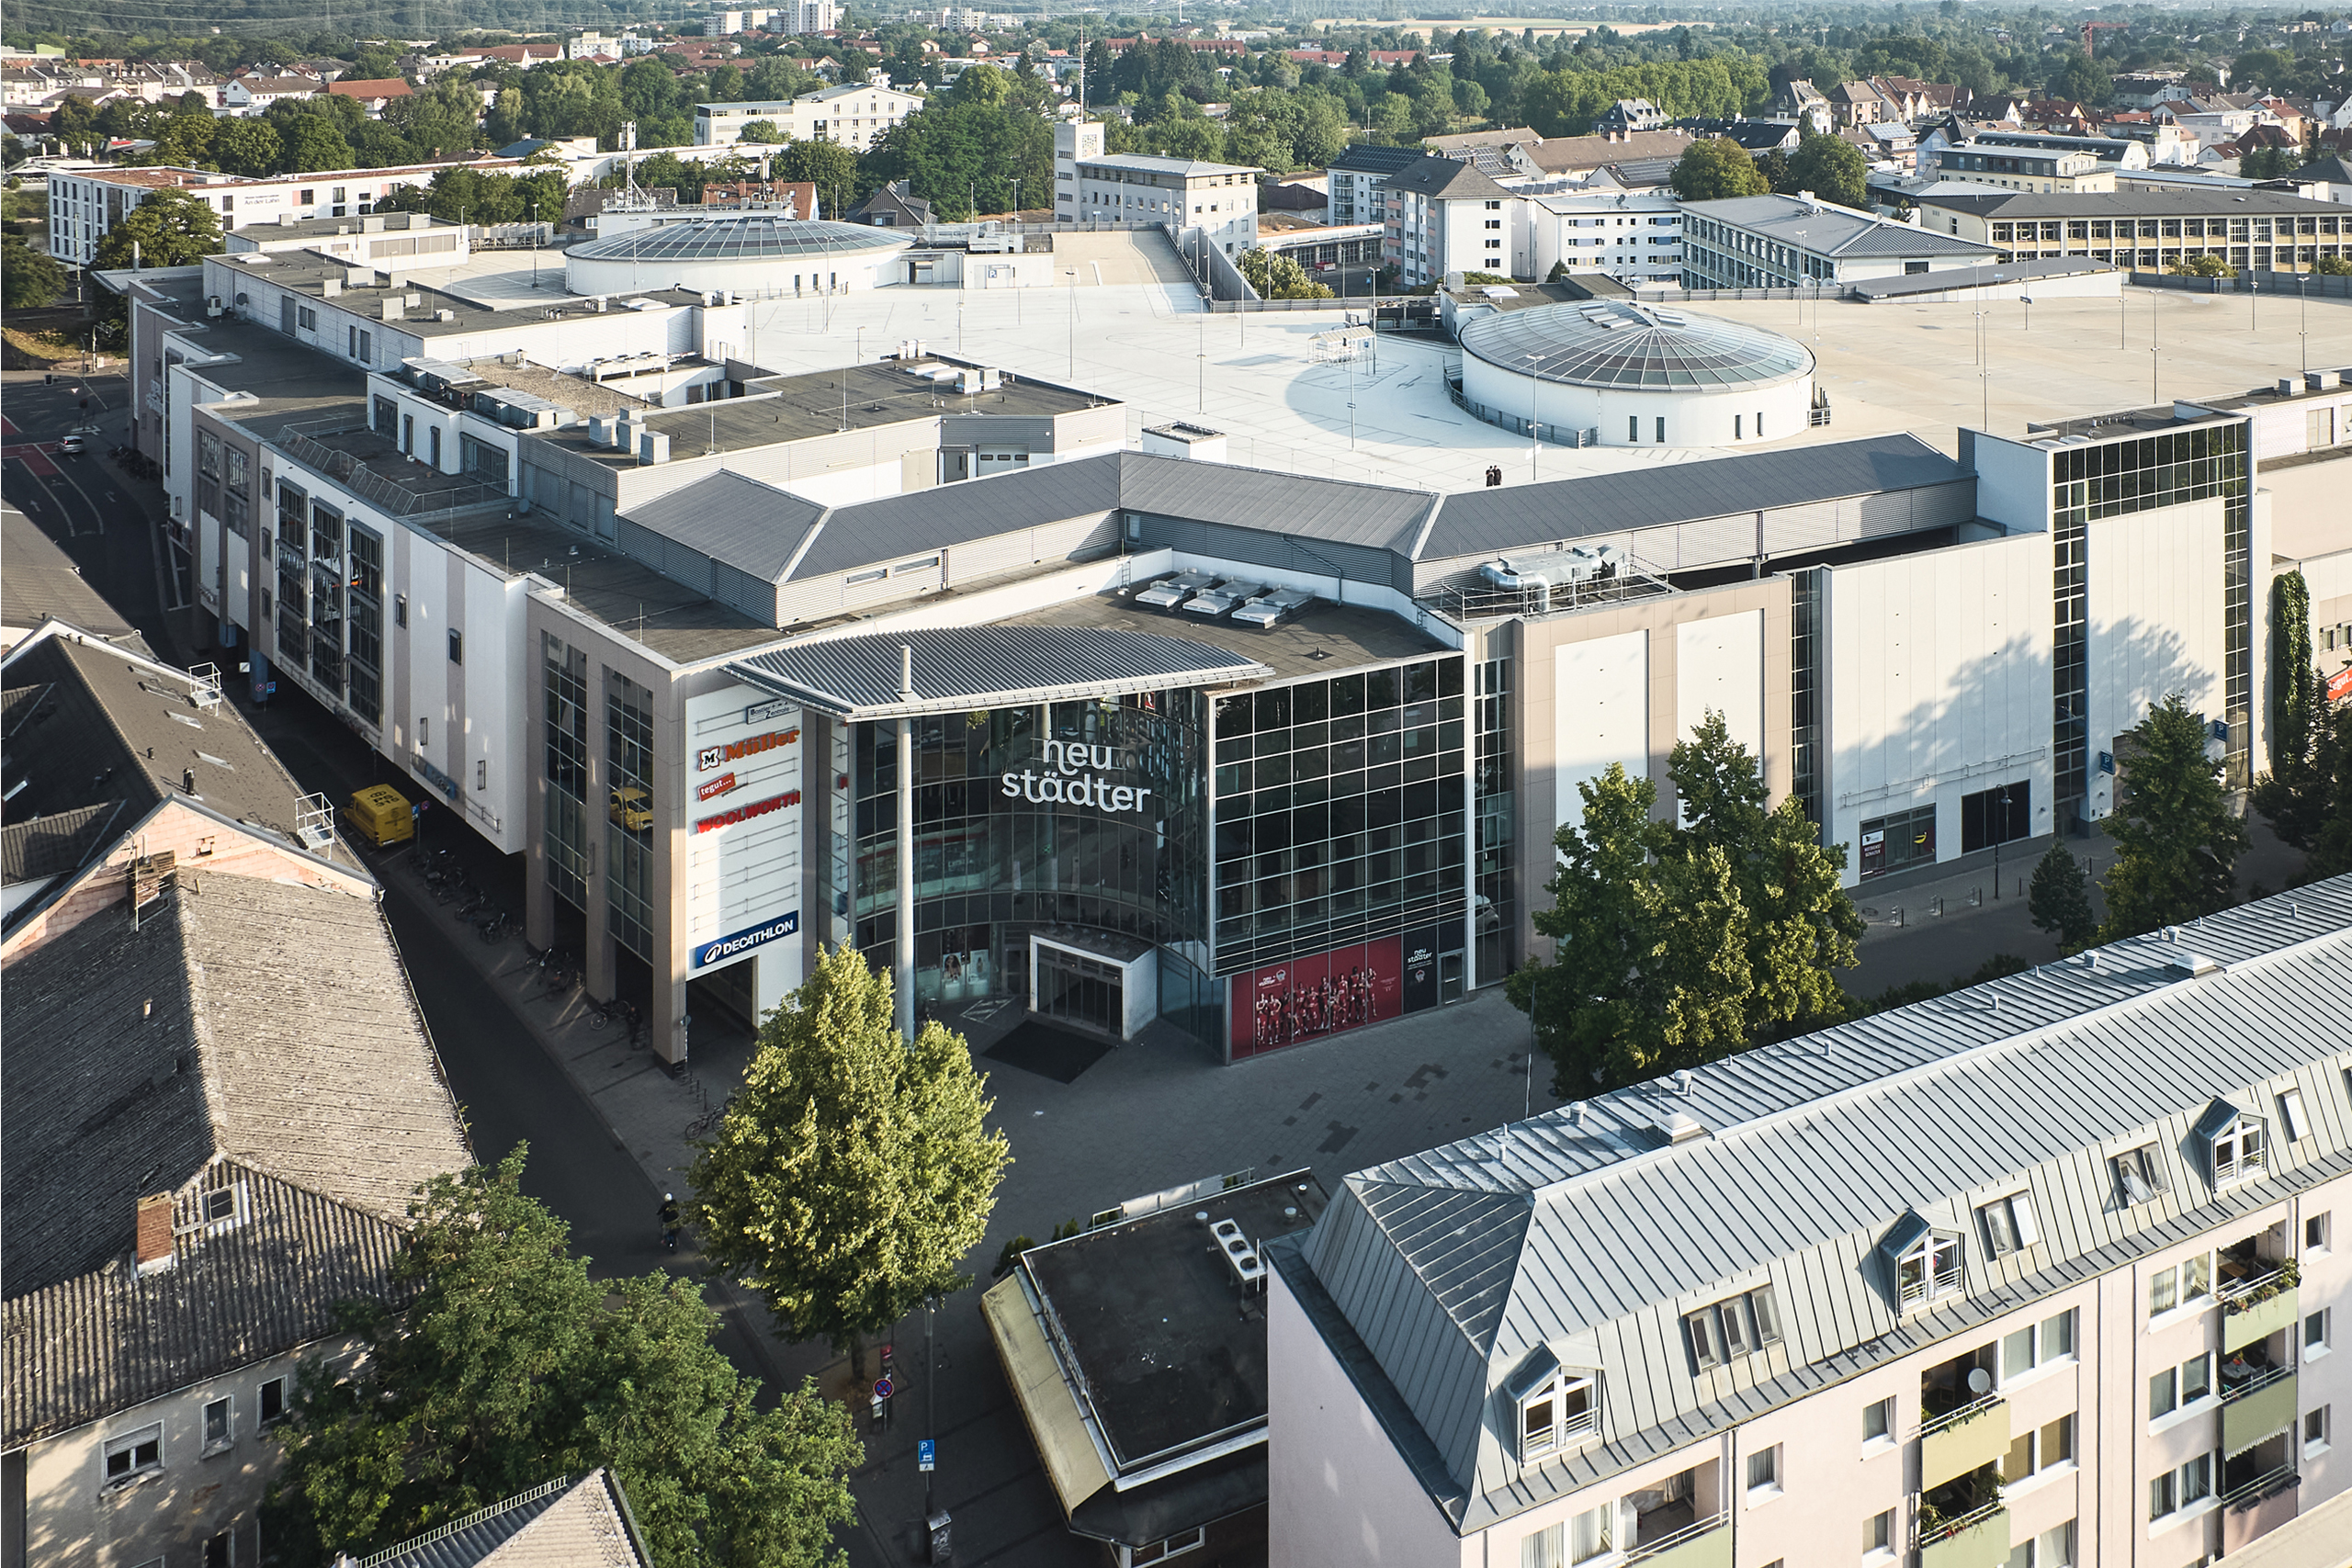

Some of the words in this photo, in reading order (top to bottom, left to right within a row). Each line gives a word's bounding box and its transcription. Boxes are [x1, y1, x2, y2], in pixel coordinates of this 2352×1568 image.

[724, 729, 800, 762] Müller
[1043, 739, 1113, 776] neu
[700, 779, 732, 795] tegut...
[1001, 769, 1152, 813] städter
[696, 791, 801, 834] WOOLWORTH
[723, 919, 794, 955] DECATHLON
[922, 1442, 928, 1451] P
